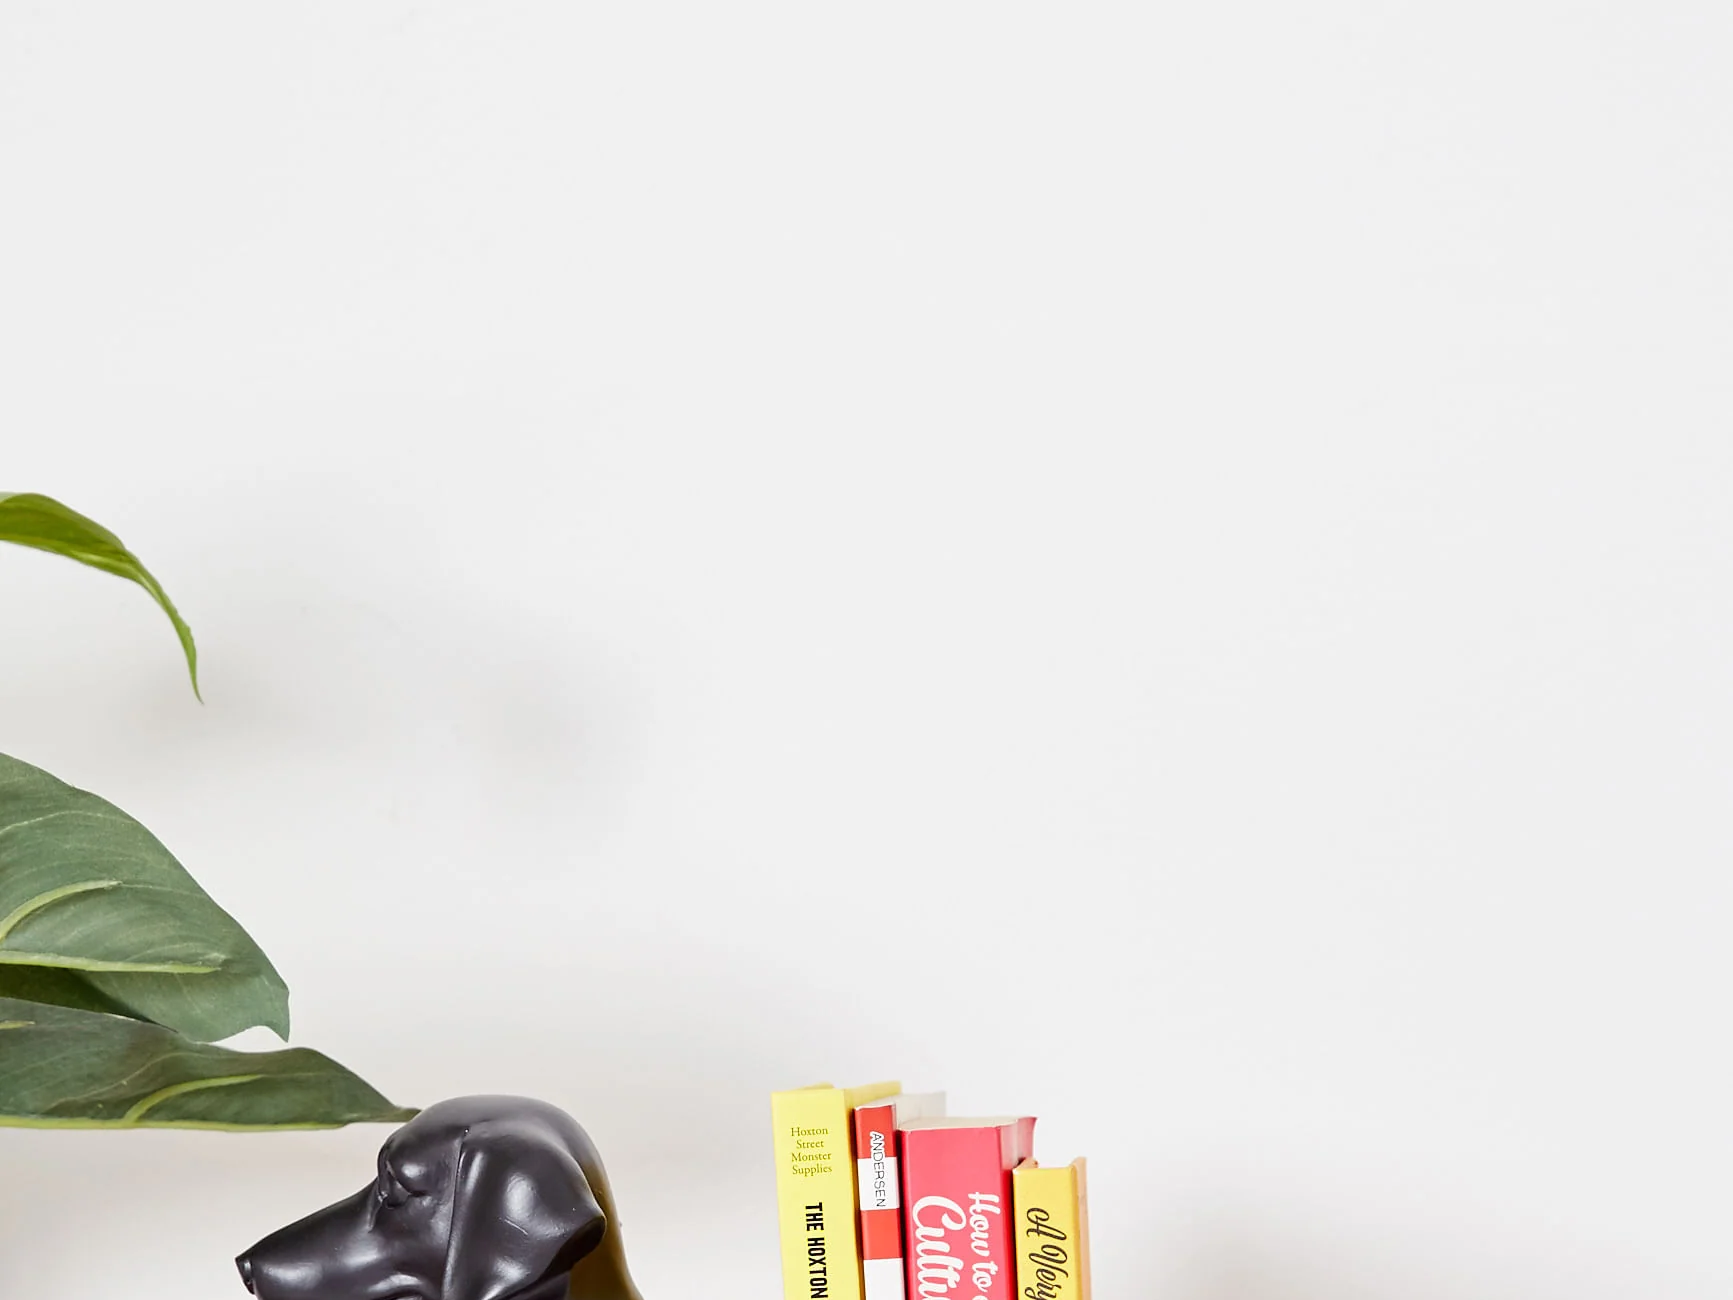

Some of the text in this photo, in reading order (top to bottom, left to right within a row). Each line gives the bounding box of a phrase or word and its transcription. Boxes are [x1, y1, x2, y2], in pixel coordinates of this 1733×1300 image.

[790, 1126, 829, 1137] Hoxton
[796, 1139, 824, 1149] Street
[791, 1151, 832, 1162] Monster
[792, 1163, 833, 1177] Supplies
[873, 1133, 886, 1207] ANDERSEN
[805, 1202, 825, 1231] THE
[968, 1191, 1001, 1257] How
[1026, 1207, 1067, 1241] A
[807, 1237, 829, 1299] HOXTON
[972, 1261, 998, 1292] to
